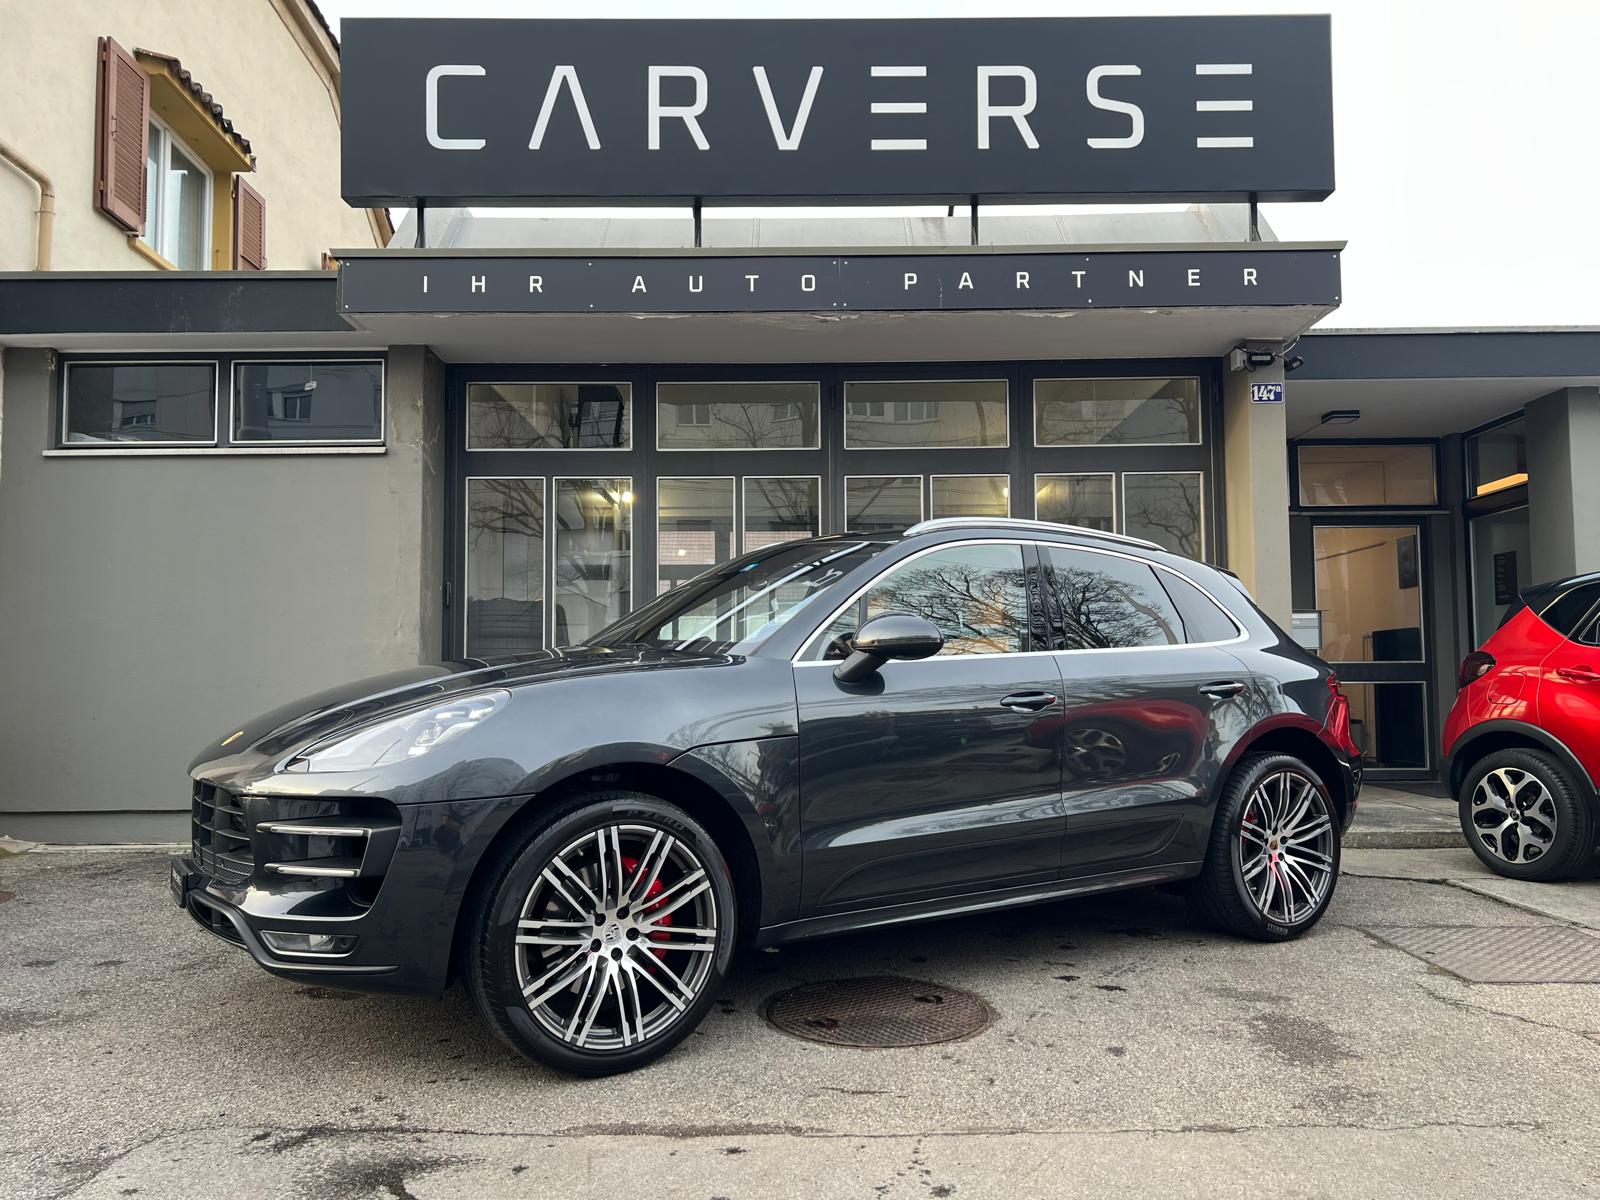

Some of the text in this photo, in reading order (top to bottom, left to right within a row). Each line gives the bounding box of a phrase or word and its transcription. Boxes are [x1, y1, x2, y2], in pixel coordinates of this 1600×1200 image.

[425, 63, 1254, 151] CARVERSE
[422, 267, 1259, 294] IHR AUTO PARTNER
